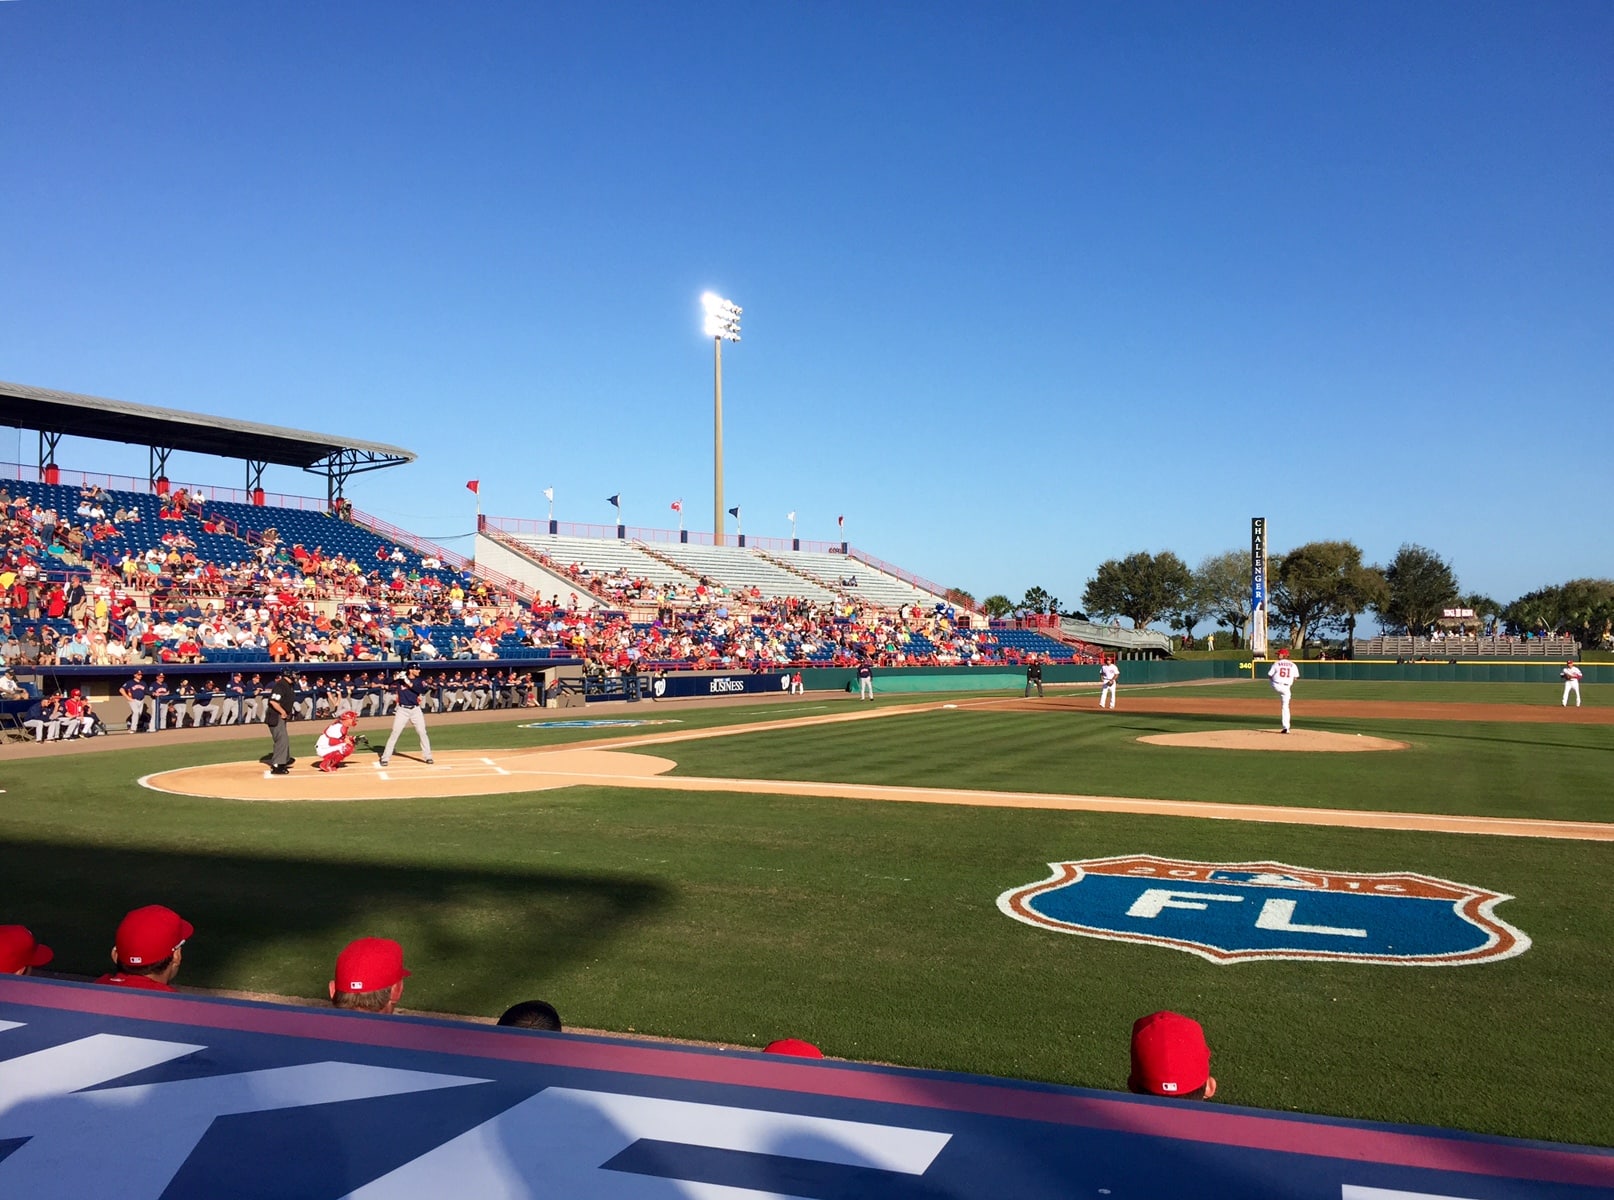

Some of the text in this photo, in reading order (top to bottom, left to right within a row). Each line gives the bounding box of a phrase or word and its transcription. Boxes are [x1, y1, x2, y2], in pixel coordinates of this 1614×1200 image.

[1254, 519, 1262, 598] CHALLENGER
[1279, 667, 1290, 678] 61
[710, 680, 744, 692] BUSINESS
[1128, 866, 1405, 892] 20 16
[1125, 888, 1368, 938] FL
